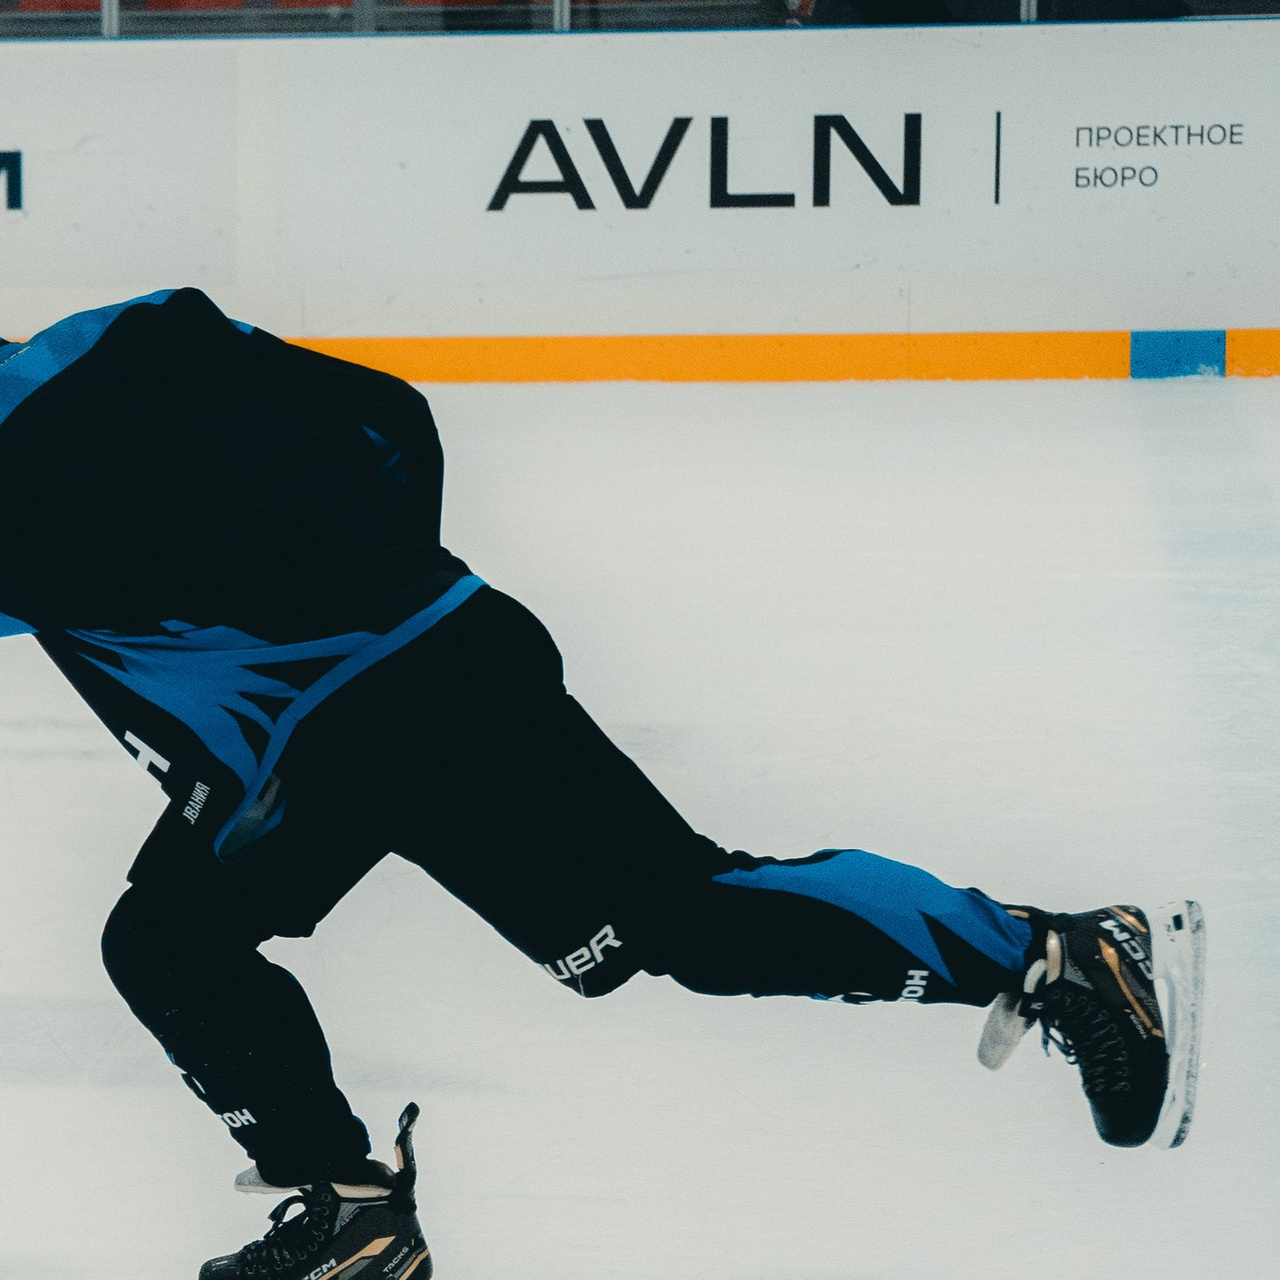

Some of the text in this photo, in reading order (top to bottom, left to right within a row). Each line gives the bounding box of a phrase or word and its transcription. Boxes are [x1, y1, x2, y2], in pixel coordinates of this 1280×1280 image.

[1075, 123, 1245, 148] ПРОЕКТНОЕ
[488, 114, 922, 212] AVLN
[1075, 166, 1160, 189] БЮРО
[382, 1245, 410, 1274] TACKS
